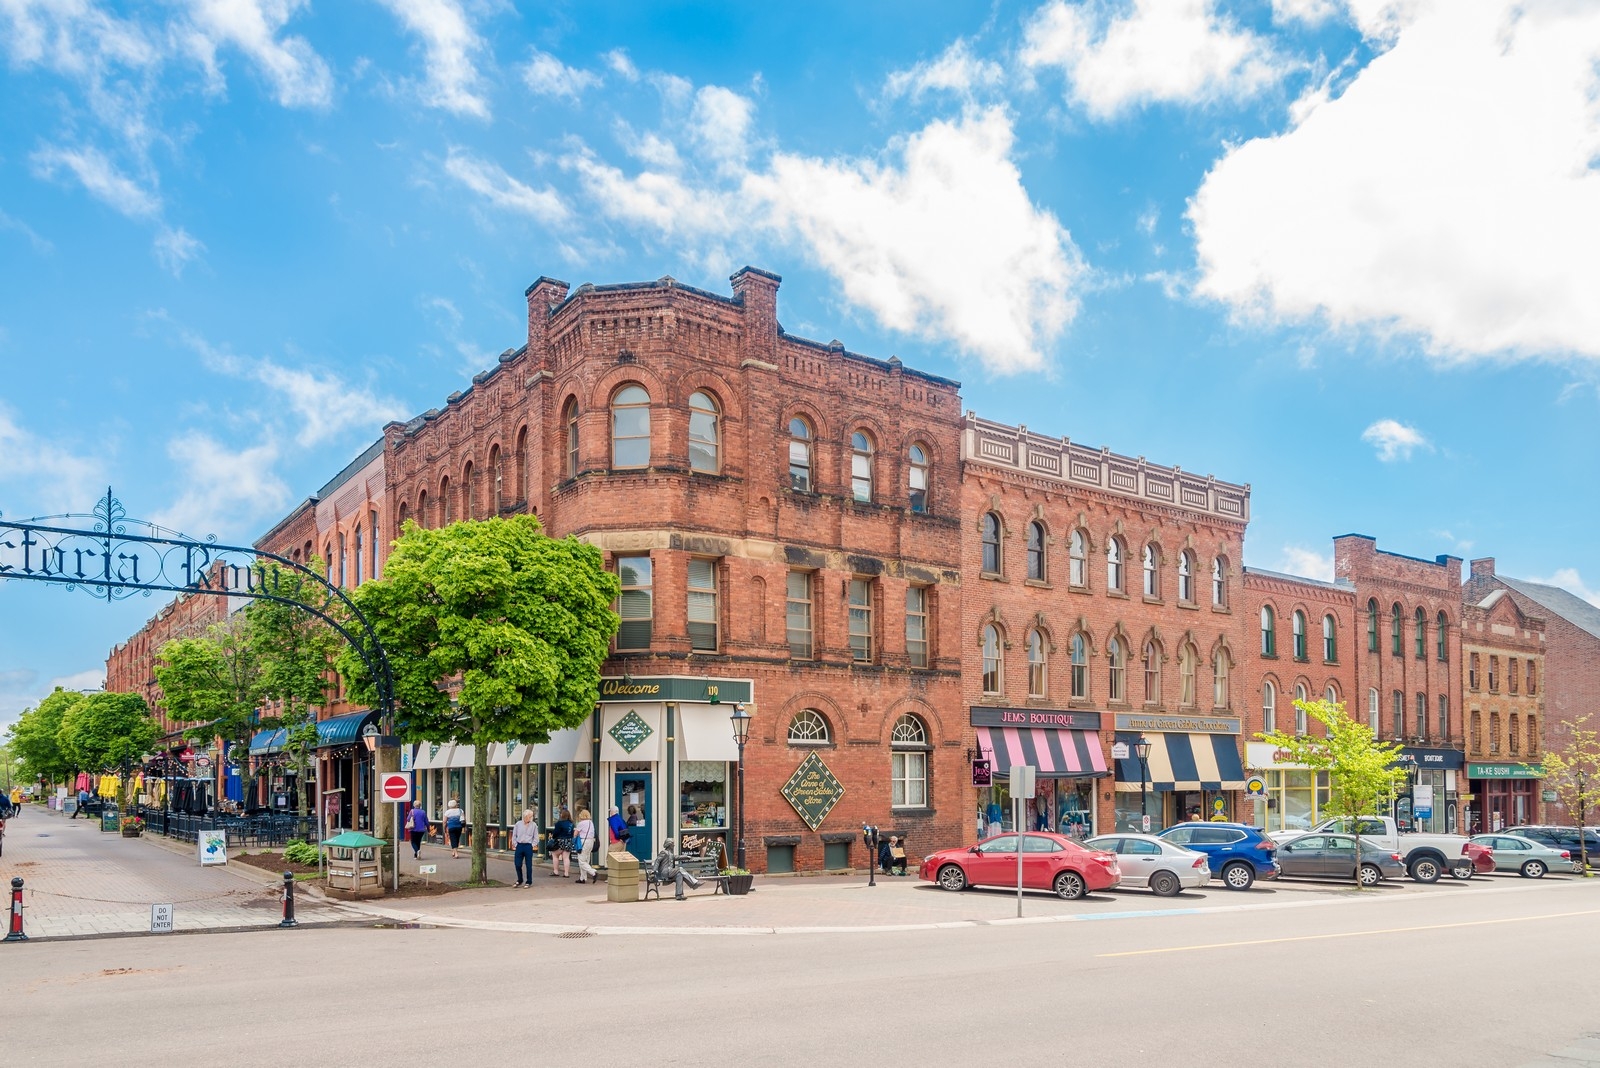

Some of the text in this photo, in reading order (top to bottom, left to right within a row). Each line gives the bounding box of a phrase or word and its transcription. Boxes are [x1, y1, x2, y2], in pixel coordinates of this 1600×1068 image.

[181, 544, 280, 594] Row
[602, 680, 660, 695] Welcome
[707, 686, 719, 696] 110
[1002, 712, 1075, 727] JEMS BOUTIQUE
[1128, 718, 1147, 729] Anne
[1148, 719, 1156, 729] of
[1156, 719, 1177, 730] Green
[1177, 719, 1197, 730] Gables
[806, 771, 820, 780] The
[1477, 767, 1493, 775] TA-KE
[1494, 767, 1510, 776] SUSHI
[800, 779, 827, 789] Anne of
[793, 786, 834, 796] Green Gables
[804, 796, 823, 805] Store
[152, 921, 171, 929] ENTER
